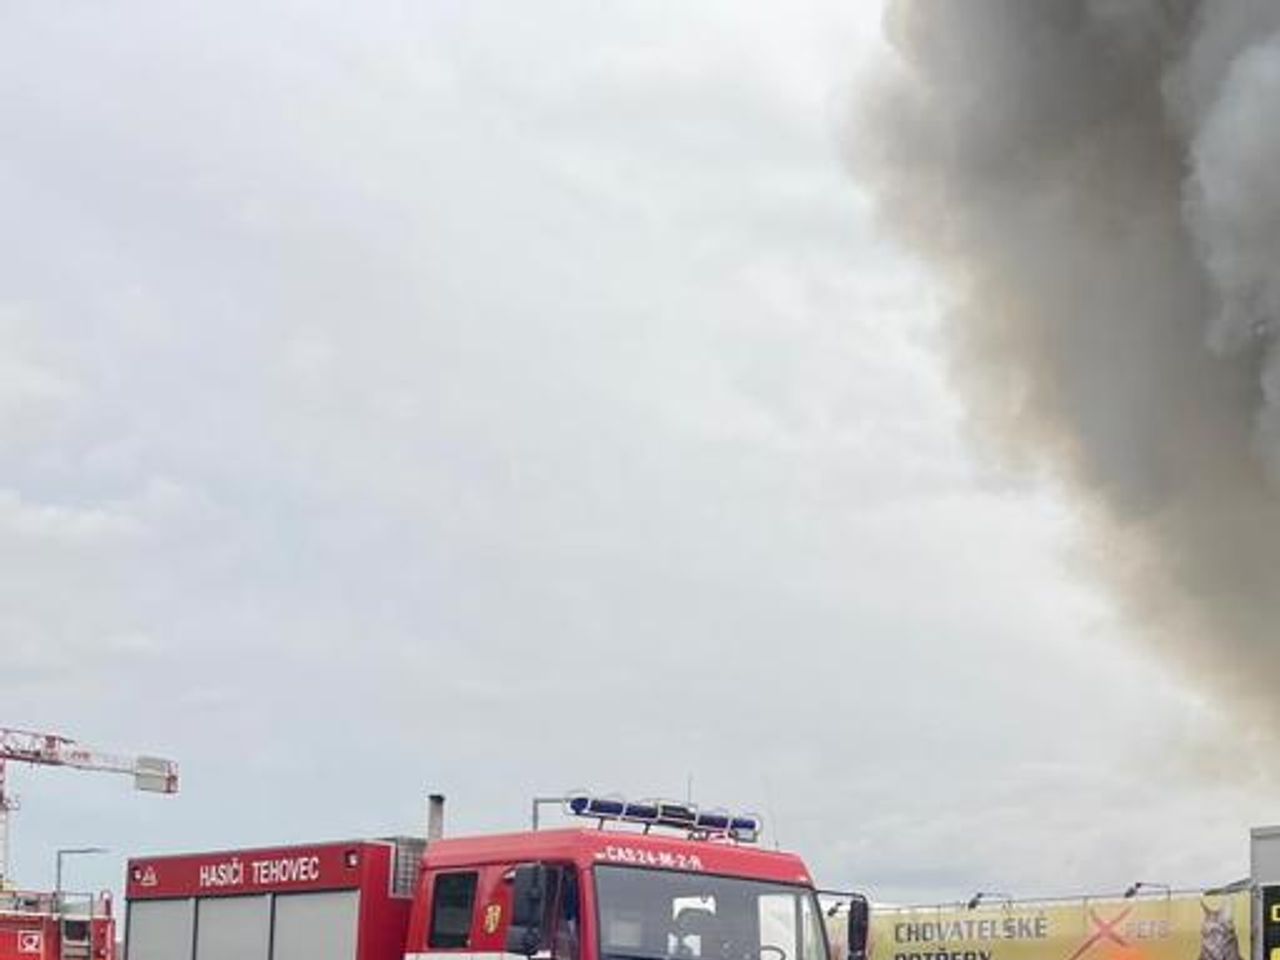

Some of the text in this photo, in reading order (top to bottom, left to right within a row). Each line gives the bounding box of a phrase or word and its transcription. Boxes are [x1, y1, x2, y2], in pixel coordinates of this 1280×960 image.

[200, 856, 319, 887] HASIČI TEHOVEC
[894, 911, 1048, 943] CHOVATELSKÉ
